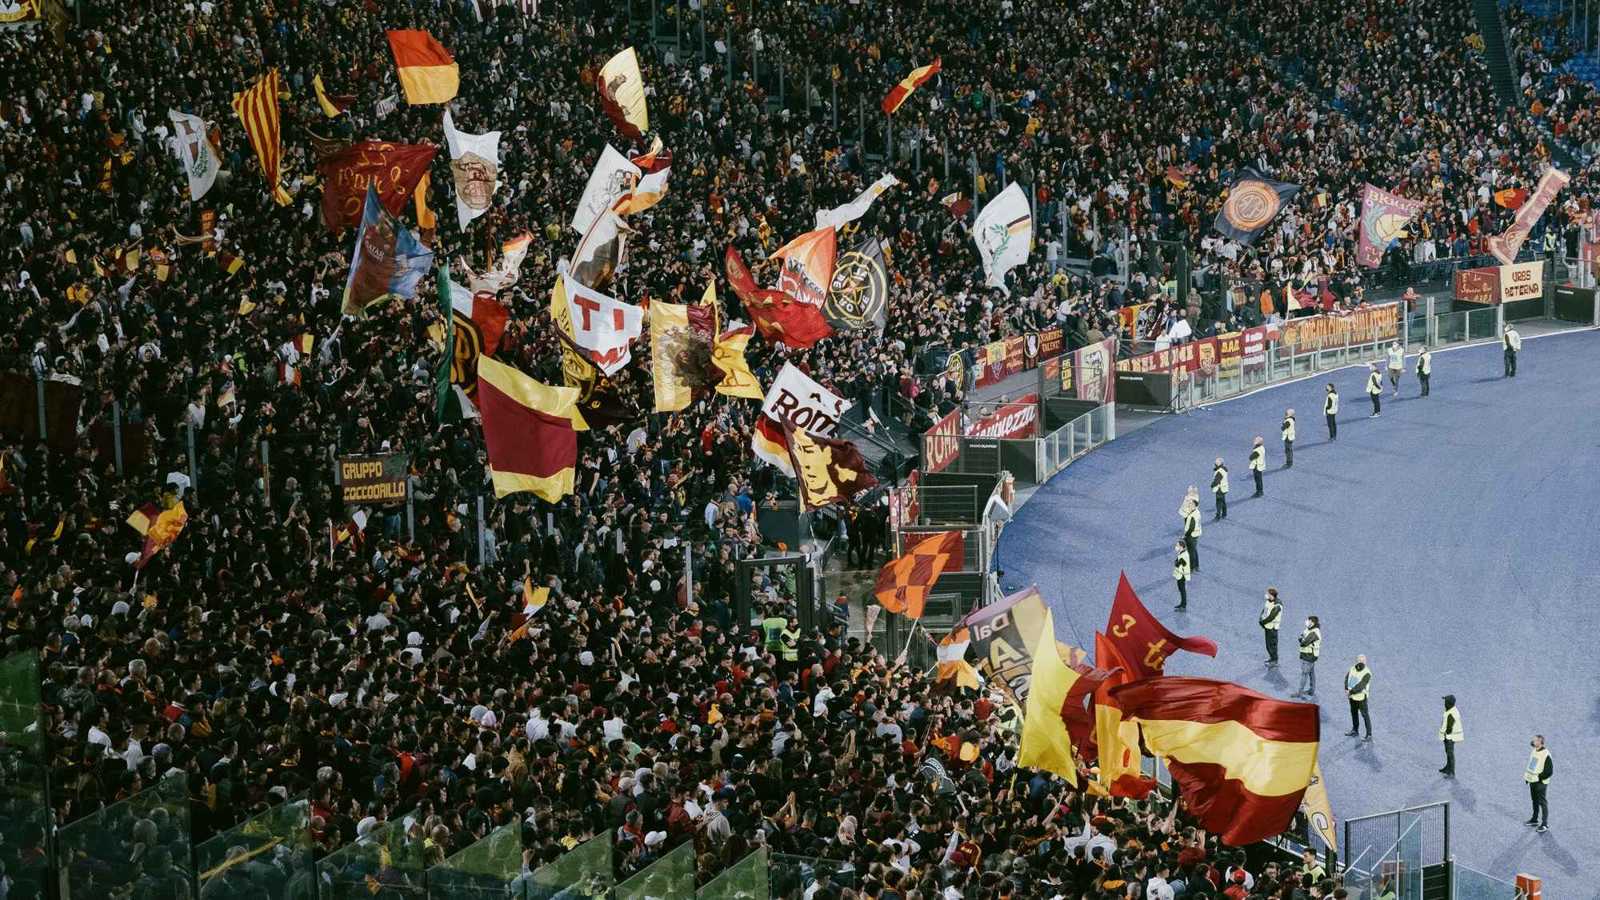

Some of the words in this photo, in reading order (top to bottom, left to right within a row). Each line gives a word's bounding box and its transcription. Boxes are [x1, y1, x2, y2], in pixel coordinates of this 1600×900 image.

[1511, 270, 1532, 283] URBS
[1504, 283, 1540, 298] AETERNA
[926, 415, 959, 473] ROMA
[342, 461, 383, 480] GRUPPO
[343, 481, 406, 501] COCCODRILLO
